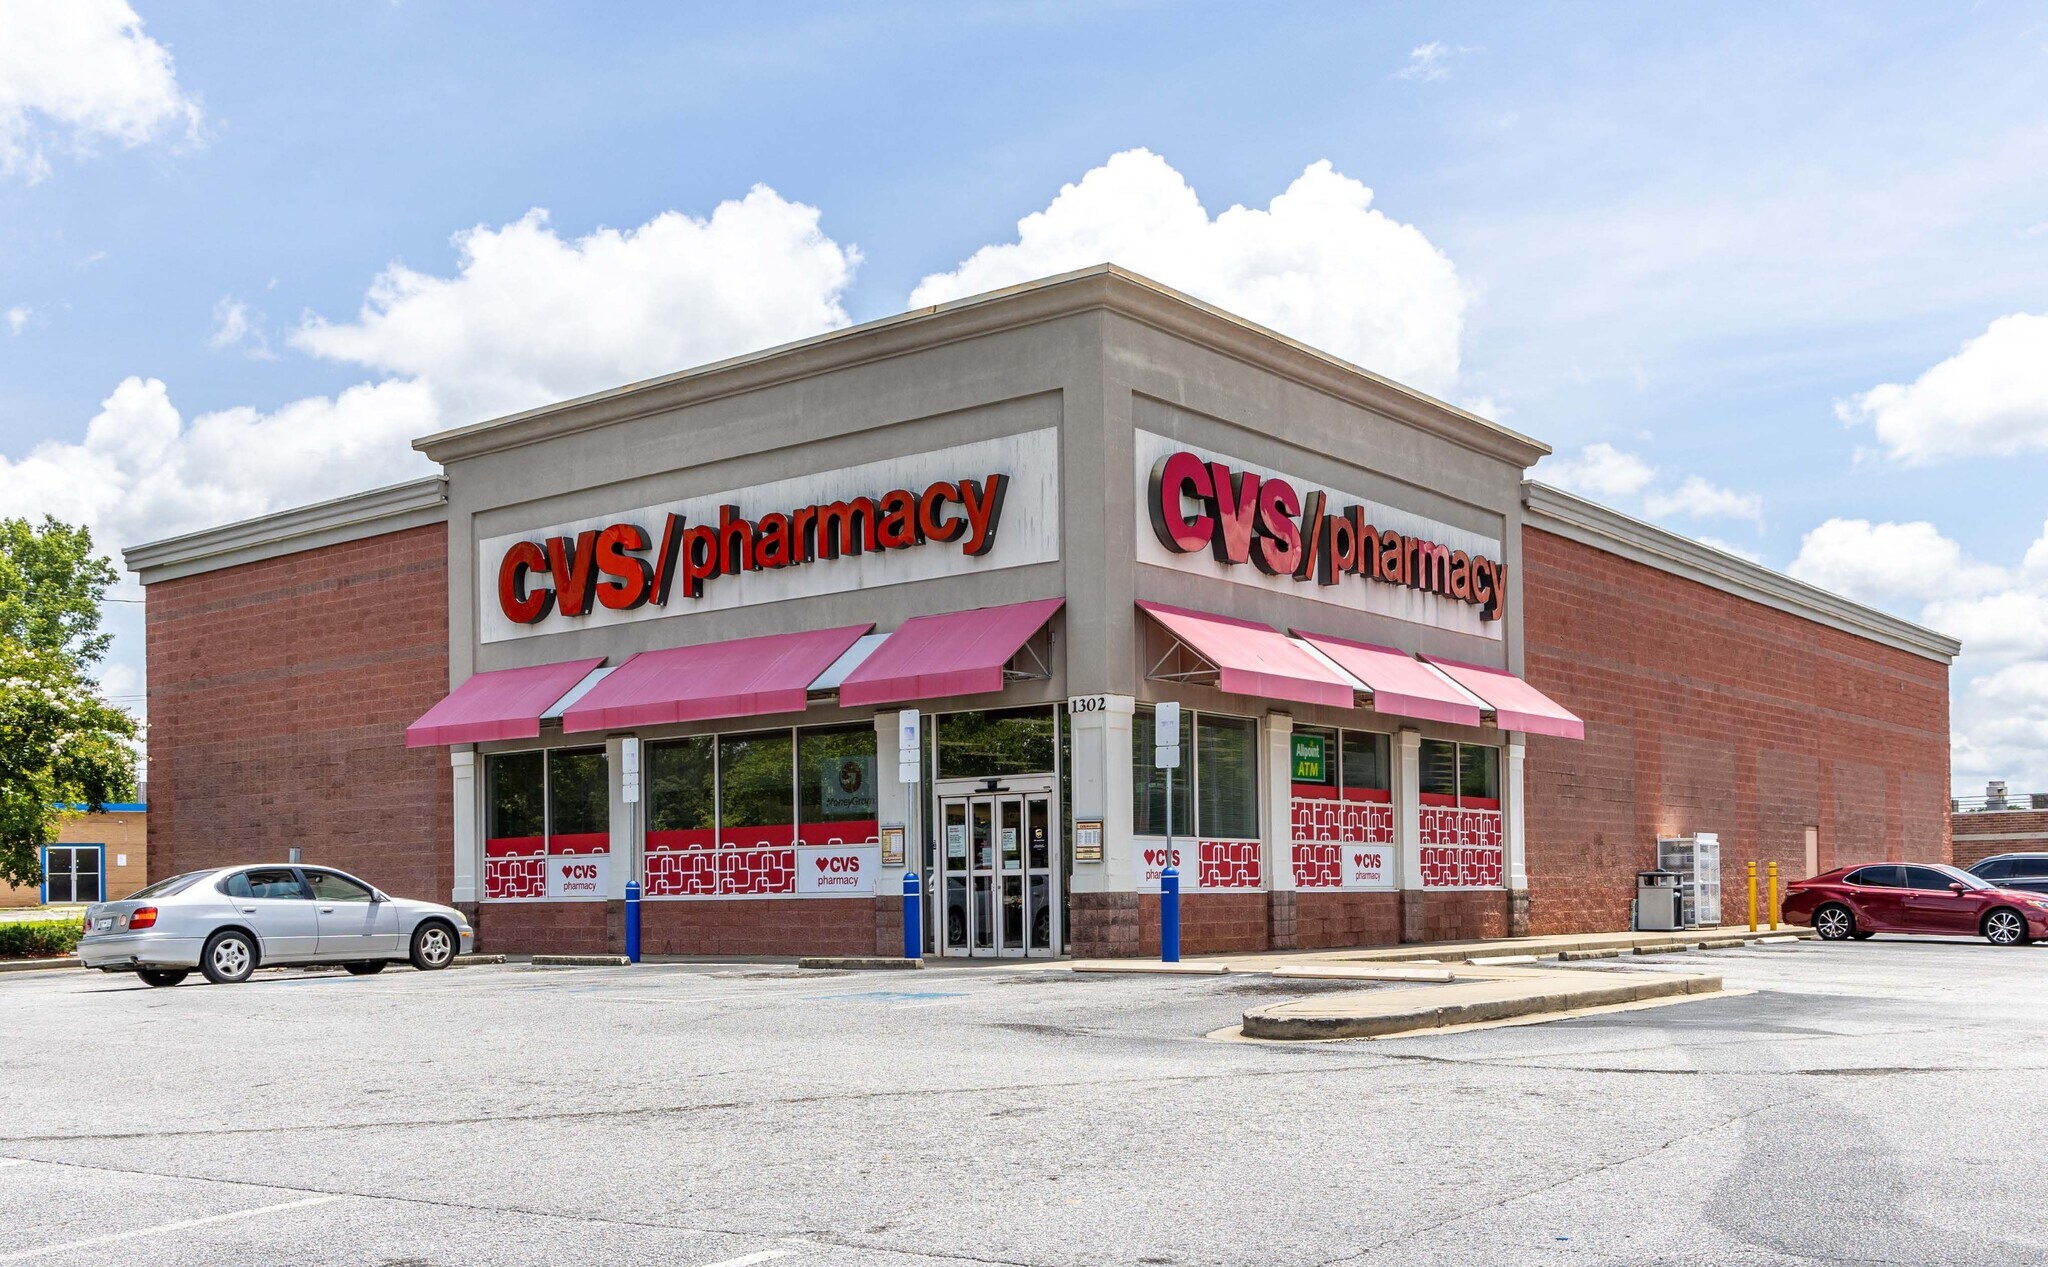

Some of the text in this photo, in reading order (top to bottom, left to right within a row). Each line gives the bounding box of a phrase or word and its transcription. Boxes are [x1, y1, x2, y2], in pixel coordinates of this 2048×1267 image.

[1149, 451, 1508, 621] CVS/pharmacy
[498, 473, 1009, 624] CVS/pharmacy
[1072, 697, 1106, 713] 1302
[1296, 743, 1320, 759] Allpoint
[1298, 761, 1319, 776] ATM
[826, 796, 876, 808] MoneyGram
[829, 856, 860, 872] CVS
[1363, 853, 1381, 868] CVS
[573, 864, 597, 879] CVS
[1356, 870, 1381, 881] pharmacy
[563, 881, 596, 892] pharmacy
[817, 875, 859, 887] pharmacy
